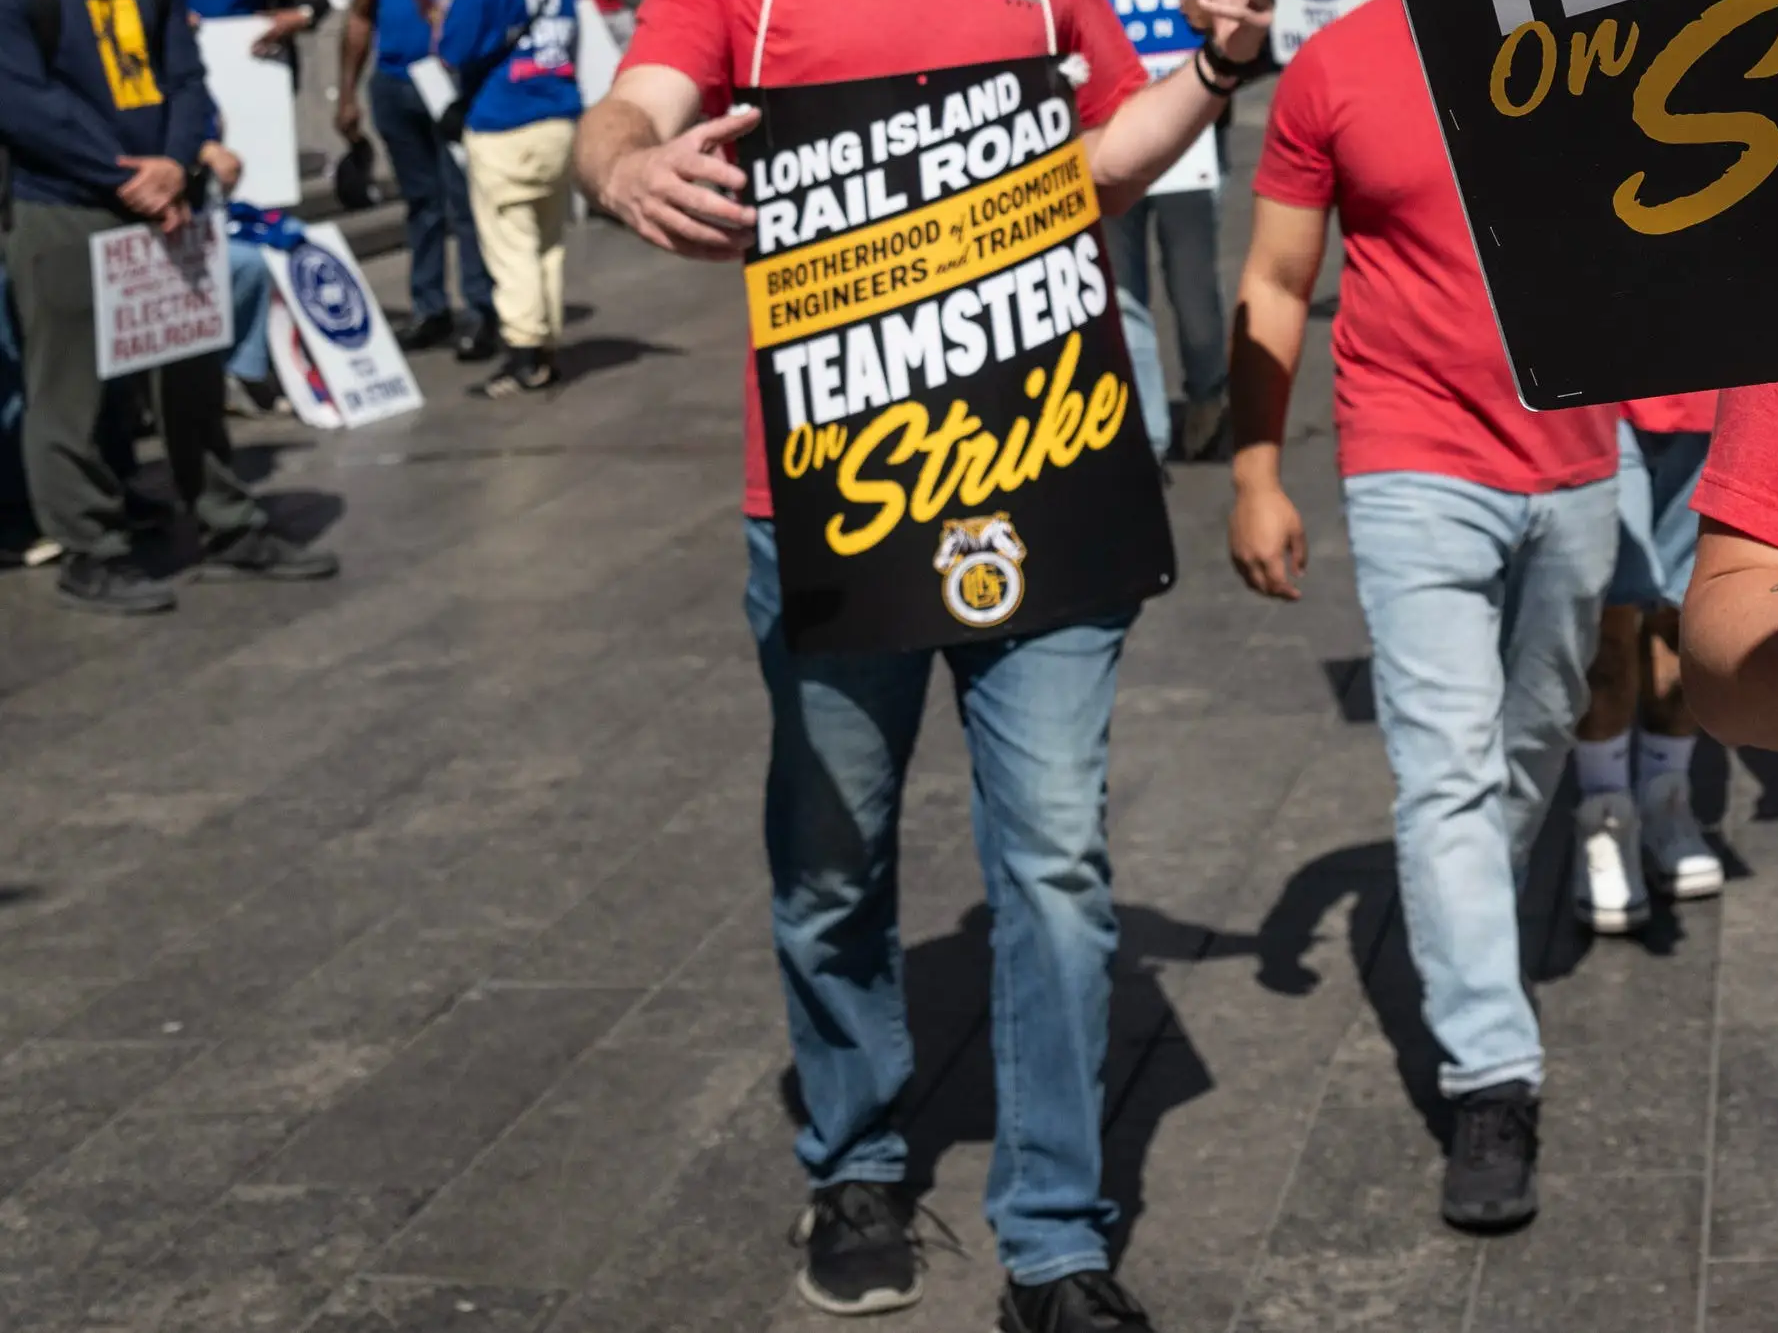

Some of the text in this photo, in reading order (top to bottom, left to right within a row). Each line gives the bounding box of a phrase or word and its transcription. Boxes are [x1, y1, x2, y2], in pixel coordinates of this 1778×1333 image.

[1489, 12, 1640, 116] On
[753, 71, 1022, 201] LONG ISLAND
[757, 97, 1072, 254] RAIL ROAD
[767, 155, 1081, 296] BROTHERHOOD of LOCOMOTIVE
[770, 188, 1087, 329] ENGINEERS and TRAINMEN
[772, 232, 1107, 430] TEAMSTERS
[783, 331, 1128, 556] On Strike
